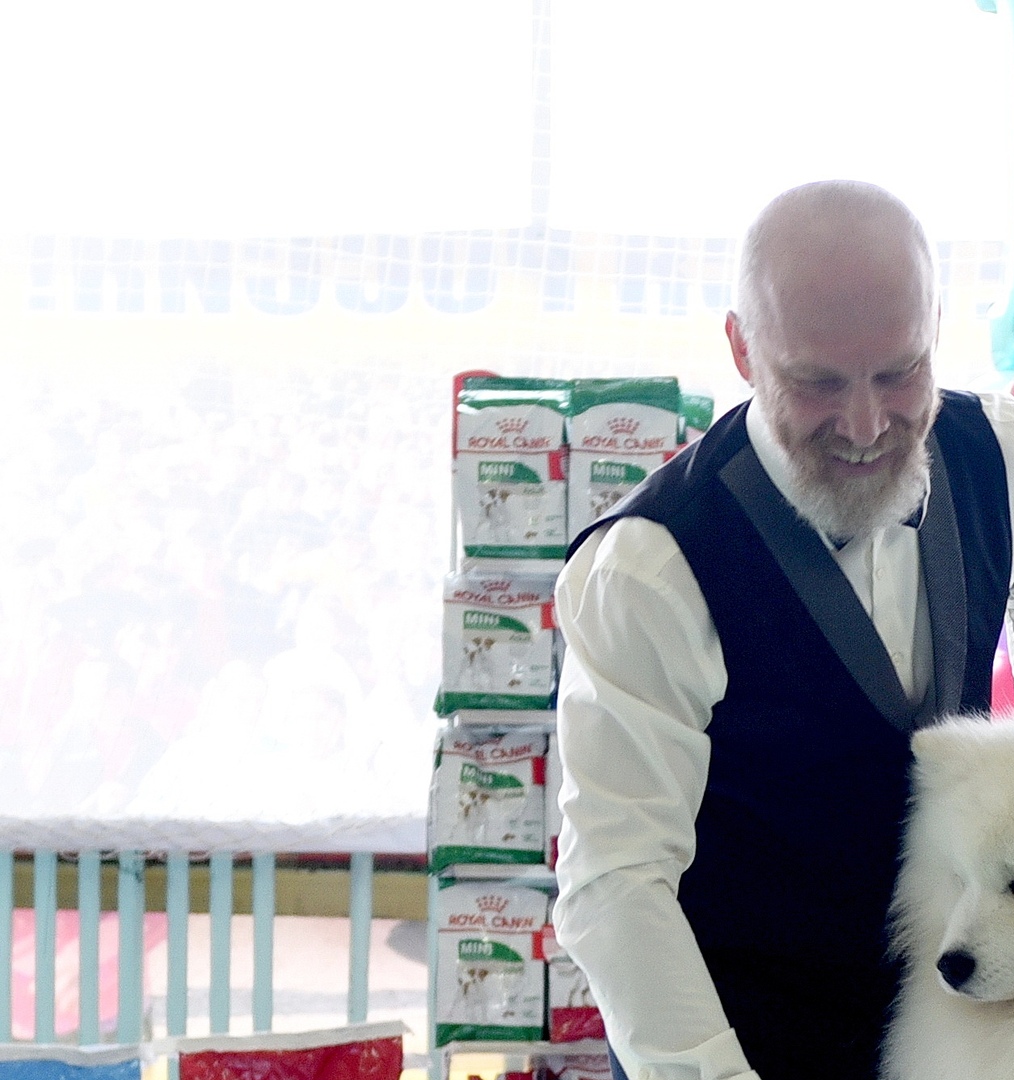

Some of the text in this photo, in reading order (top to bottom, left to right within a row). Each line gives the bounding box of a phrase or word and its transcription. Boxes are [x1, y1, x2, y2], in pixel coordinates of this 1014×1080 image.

[468, 436, 509, 448] ROYAL
[582, 436, 620, 448] ROYAL
[480, 464, 514, 476] MINI
[592, 463, 626, 475] MINI
[466, 613, 500, 626] MINI
[449, 914, 486, 926] ROYAL
[461, 942, 493, 956] MINI
